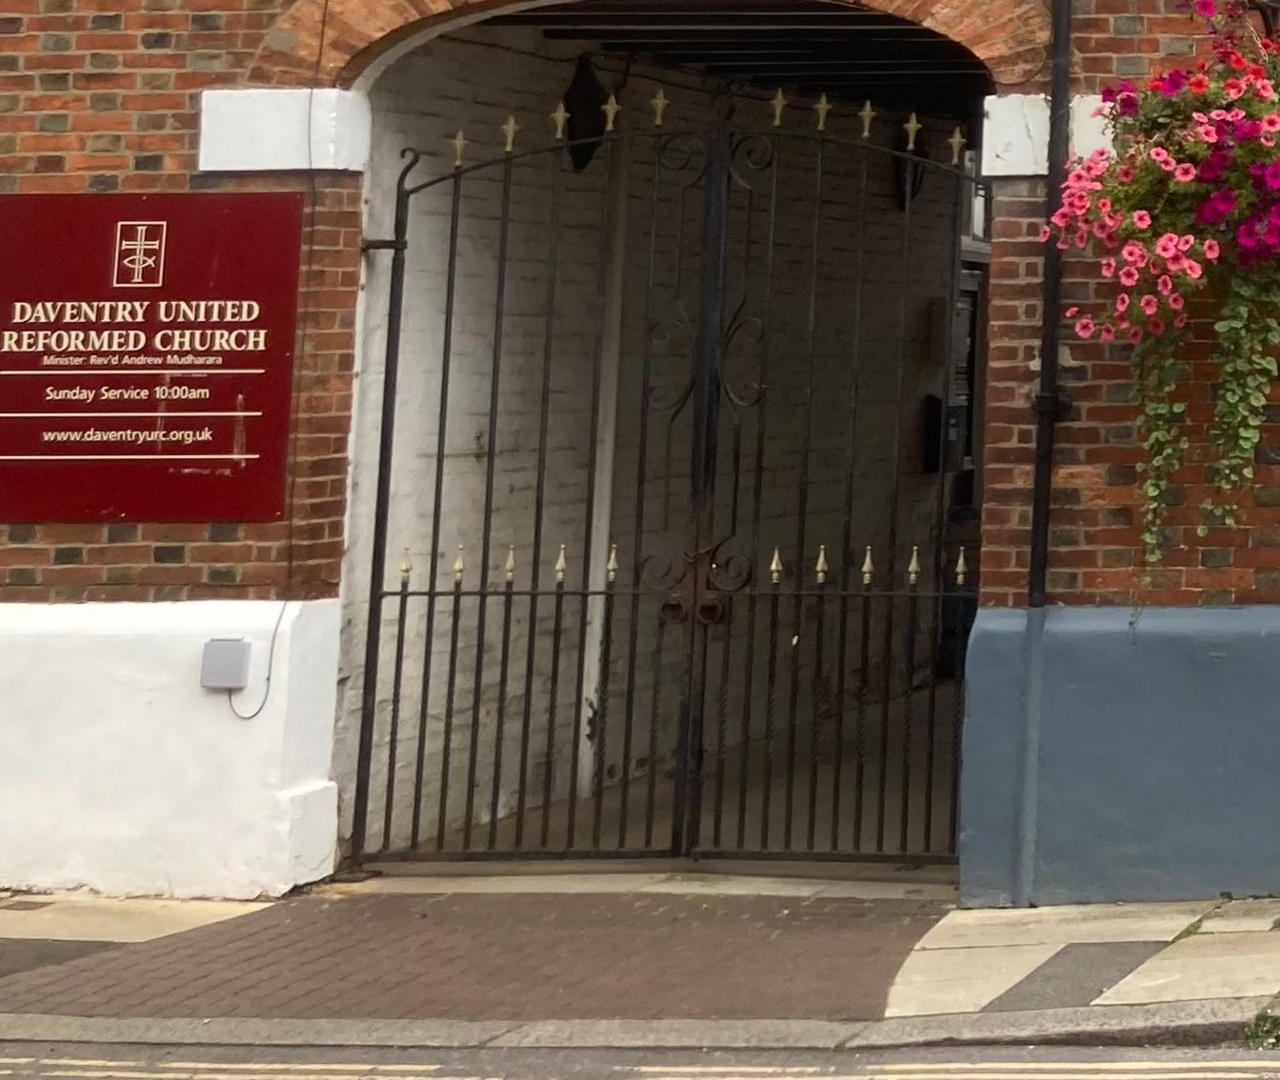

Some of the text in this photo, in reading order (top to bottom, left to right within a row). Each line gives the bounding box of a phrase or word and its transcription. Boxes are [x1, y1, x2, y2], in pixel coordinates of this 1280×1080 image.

[12, 300, 260, 324] DAVENTRY UNITED
[1, 328, 267, 353] REFORMED CHURCH
[122, 354, 164, 366] Andrew
[45, 385, 210, 403] Sunday Service 10:00am
[42, 427, 213, 445] www.daventryurc.org.uk
